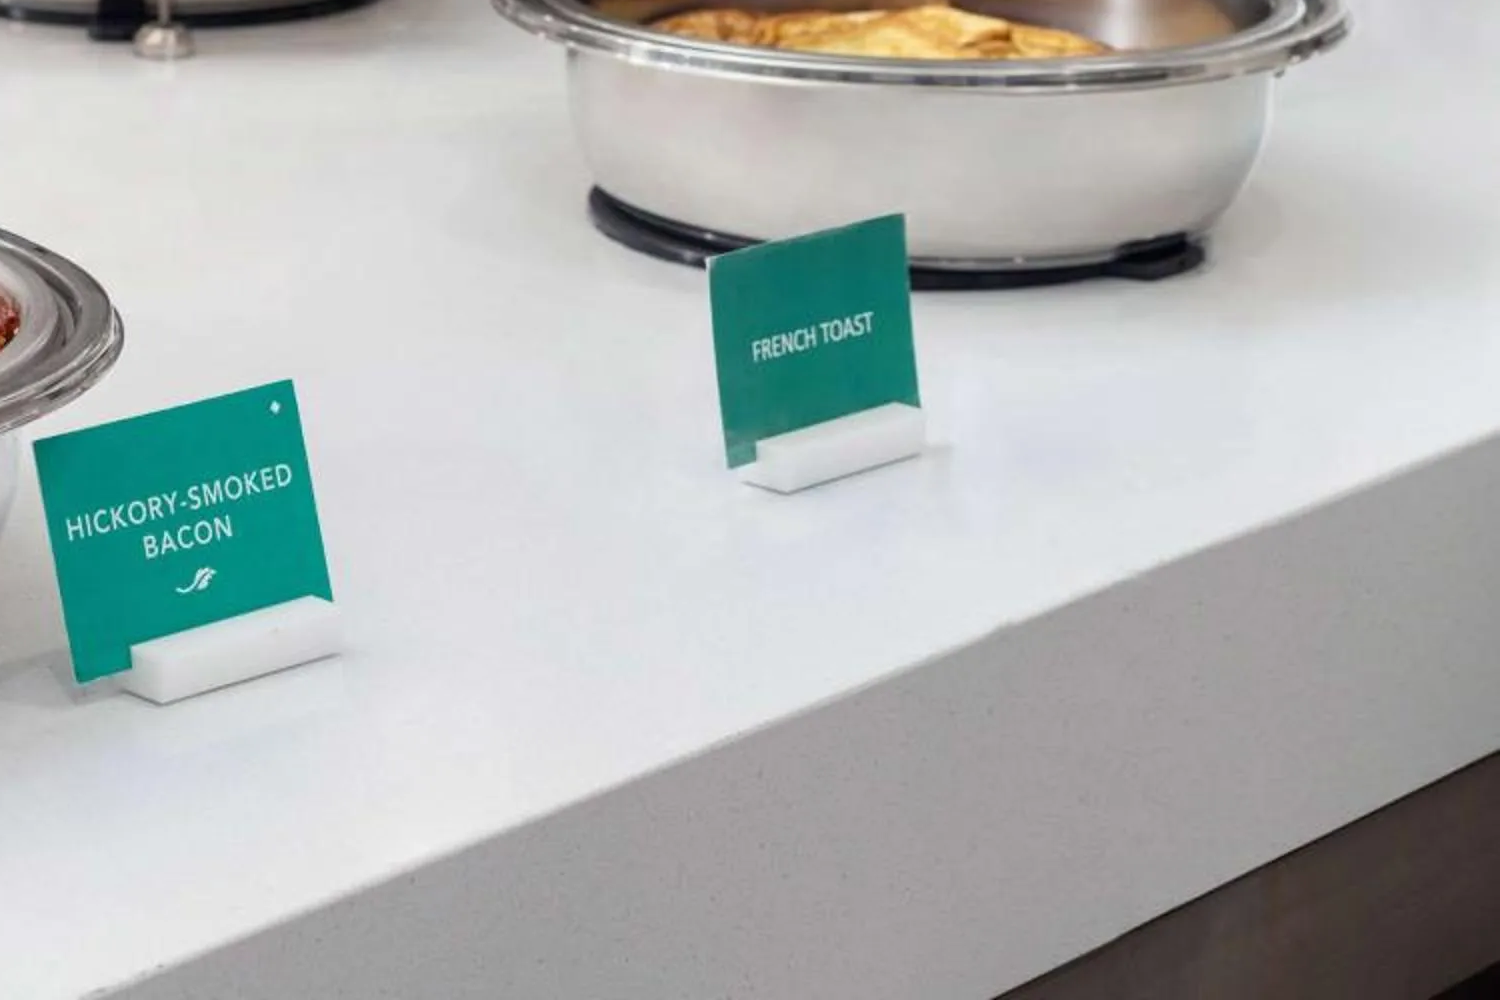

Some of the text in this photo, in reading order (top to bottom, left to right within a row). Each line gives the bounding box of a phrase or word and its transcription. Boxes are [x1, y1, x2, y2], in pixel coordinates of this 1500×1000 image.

[752, 312, 874, 362] FRENCH TOAST
[65, 463, 293, 541] HICKORY-SMOKED
[142, 515, 233, 559] BACON
